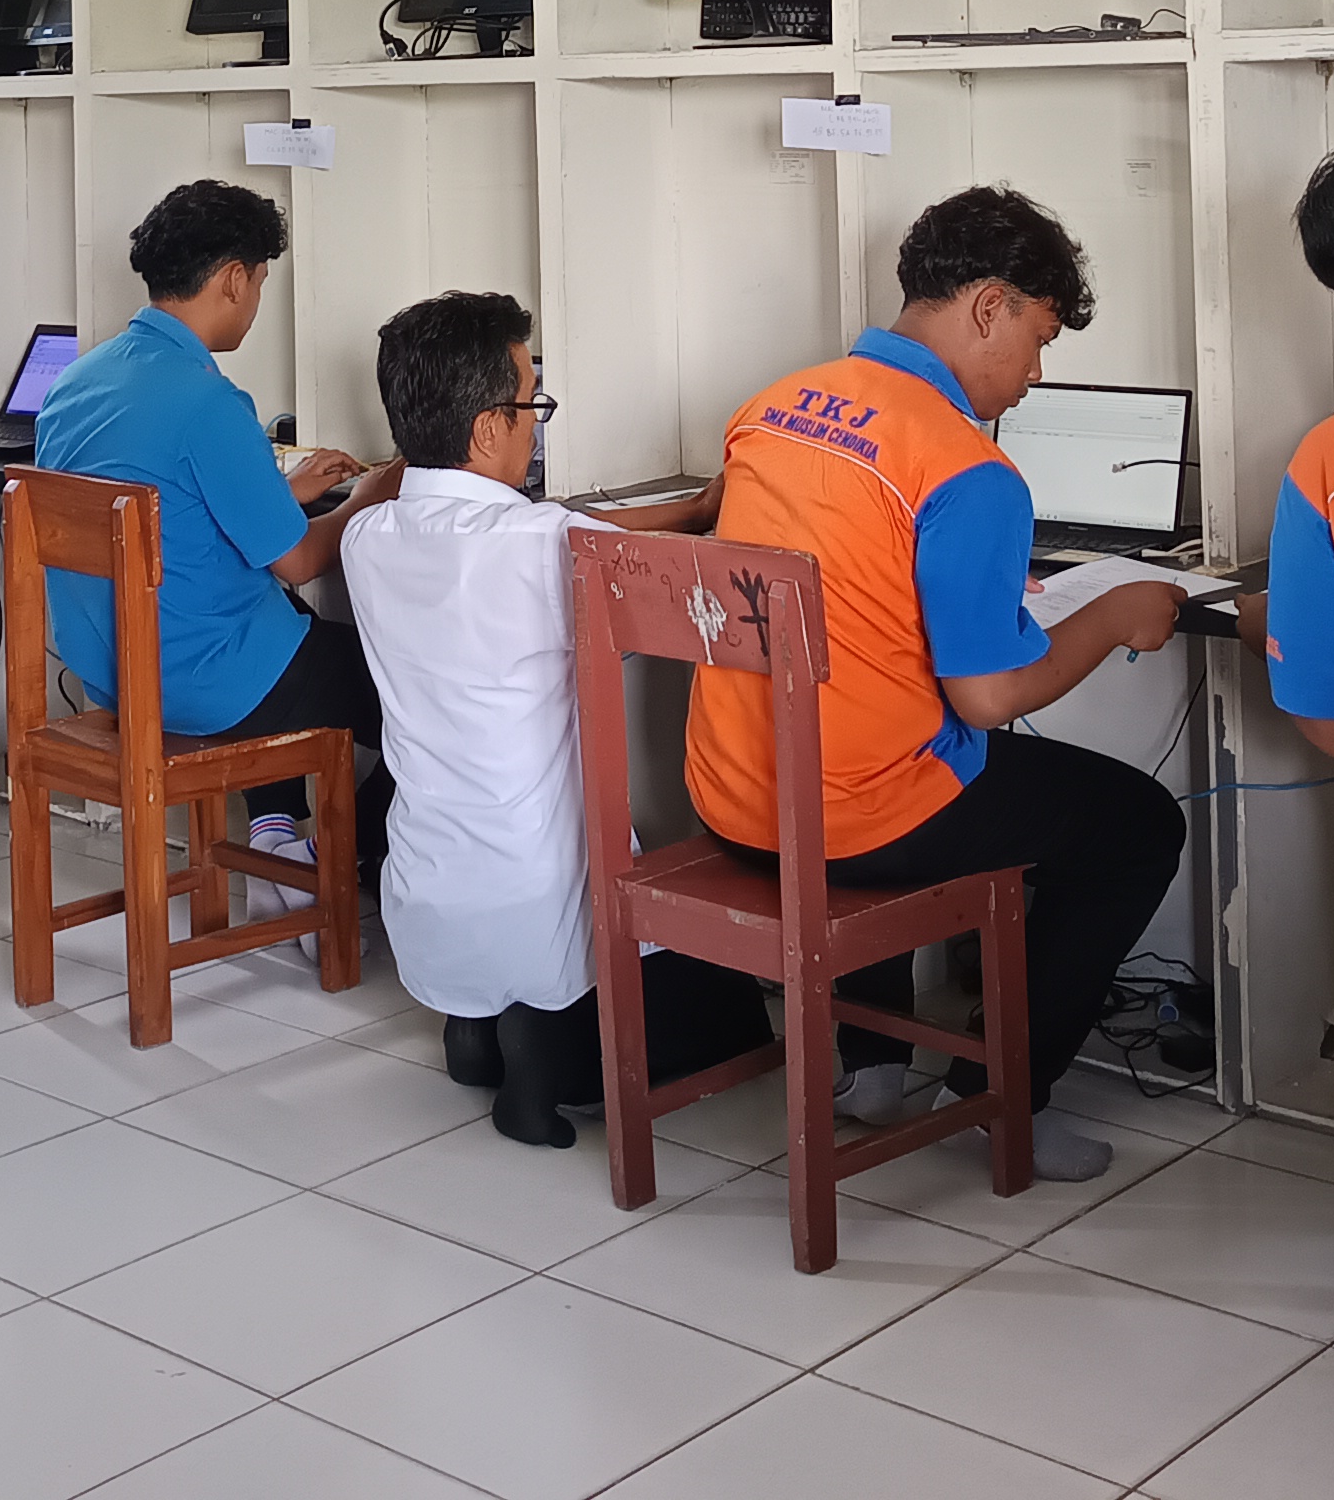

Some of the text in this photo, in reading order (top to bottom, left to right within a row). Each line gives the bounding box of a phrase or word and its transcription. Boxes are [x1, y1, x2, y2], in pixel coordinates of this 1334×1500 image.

[760, 406, 880, 463] SMK MUSLIM CENDIKIA
